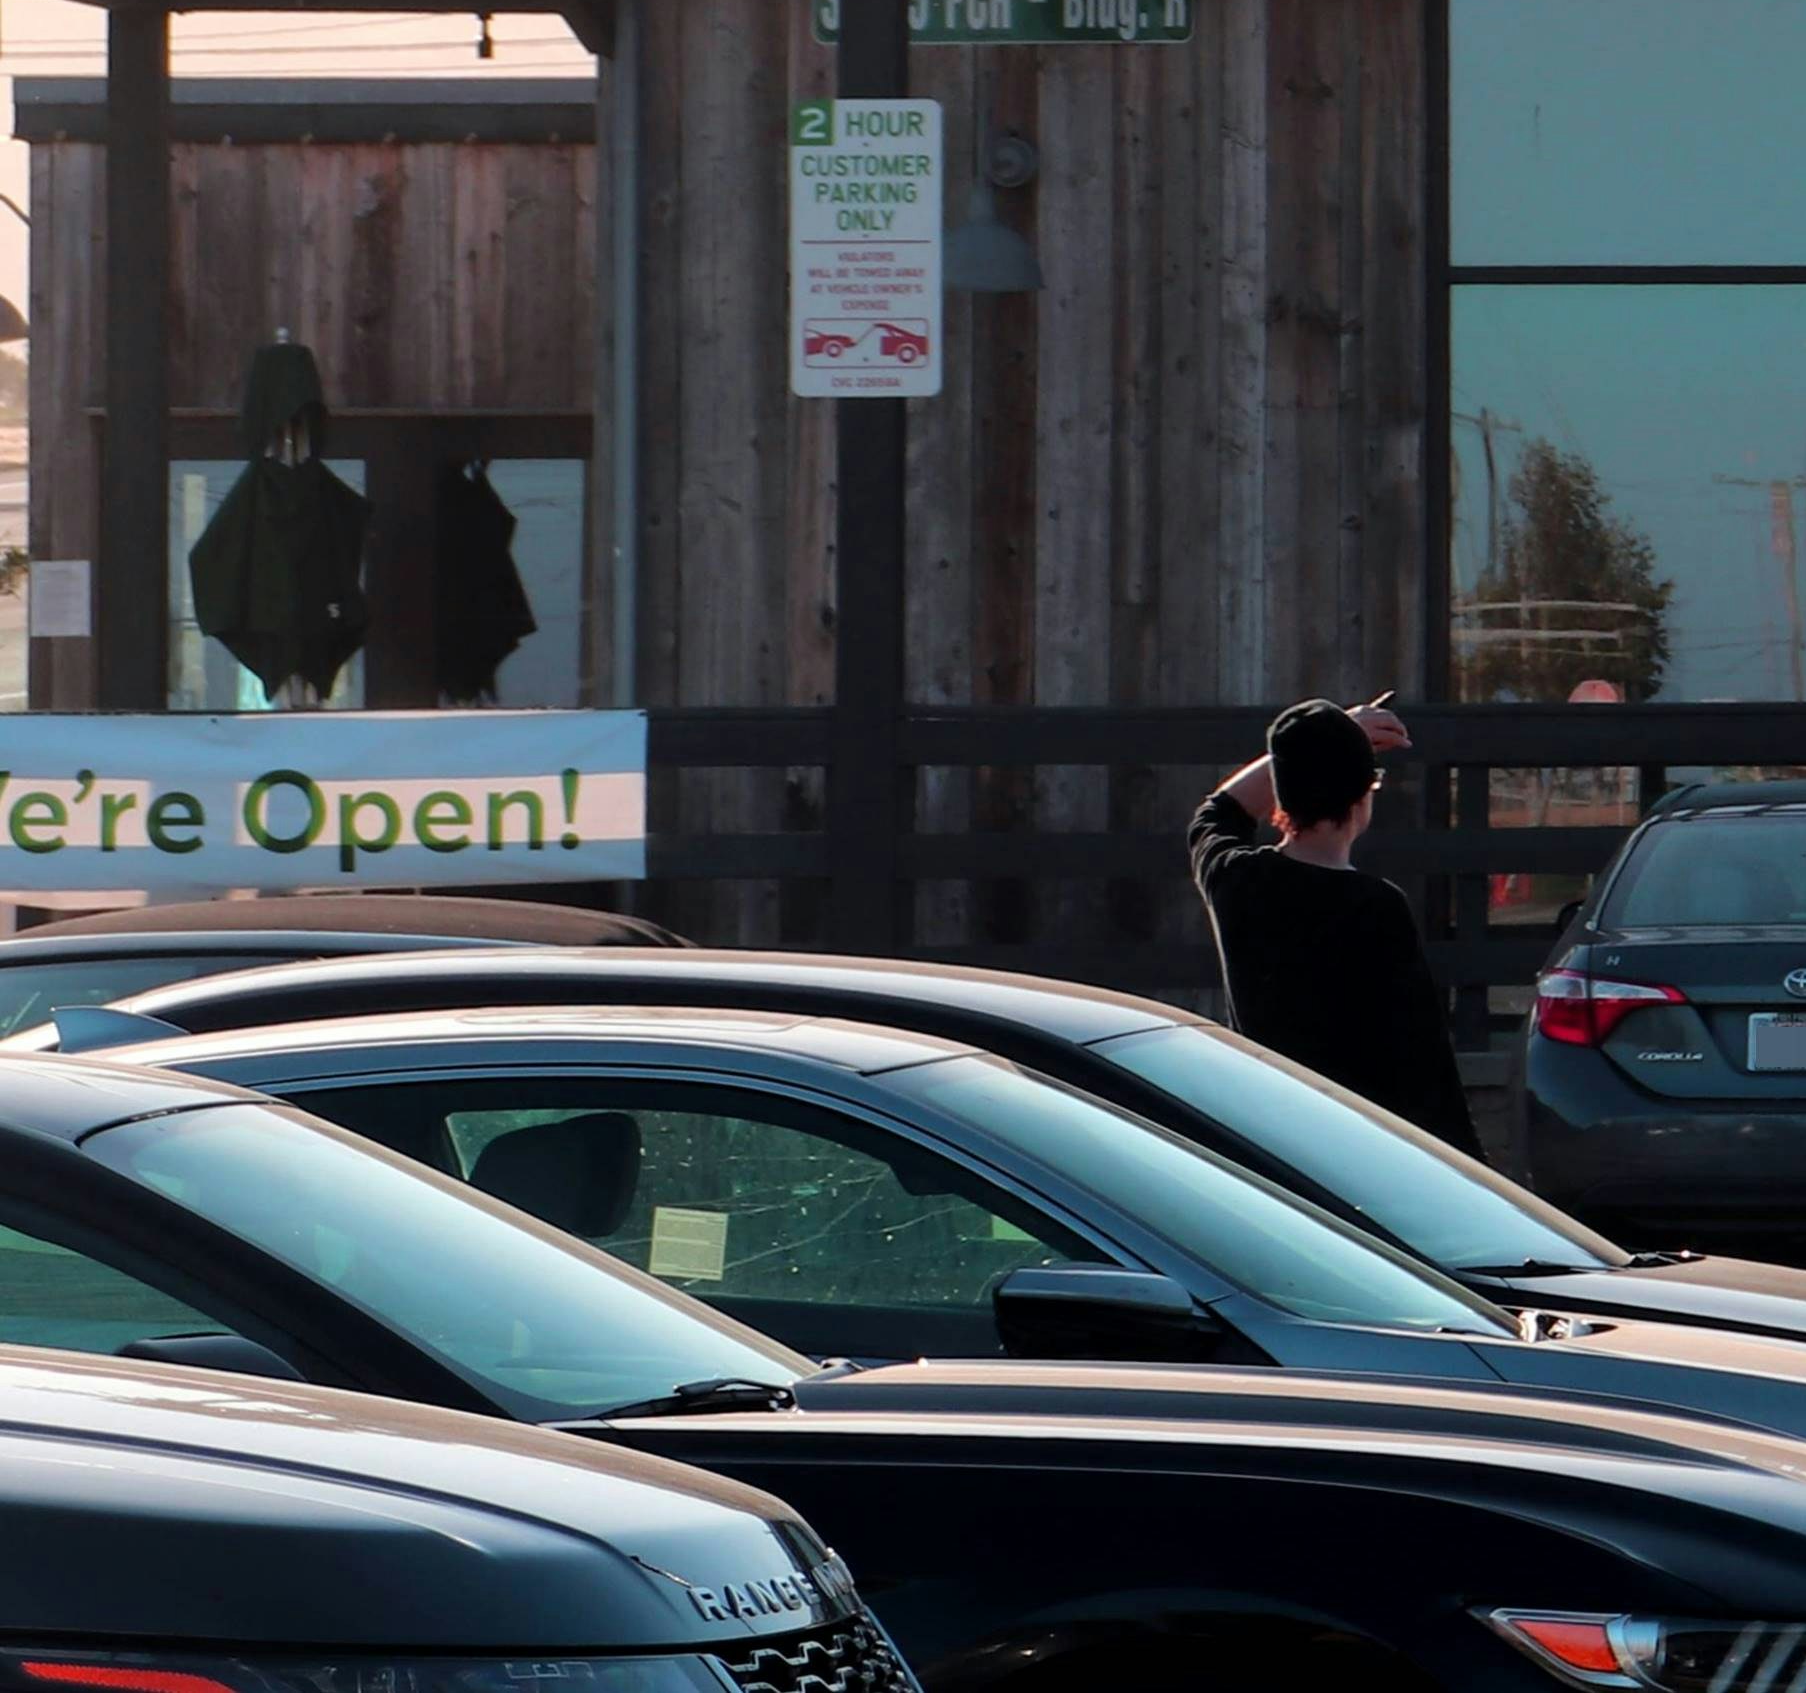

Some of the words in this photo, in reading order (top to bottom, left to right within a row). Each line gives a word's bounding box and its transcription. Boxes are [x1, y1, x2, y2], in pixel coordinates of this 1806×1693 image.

[799, 107, 827, 139] 2
[845, 110, 924, 137] HOUR
[800, 154, 931, 177] CUSTOMER
[815, 182, 918, 203] PARKING
[836, 209, 894, 231] ONLY
[243, 768, 580, 873] Open!
[1637, 1051, 1704, 1061] COROLLA
[687, 1571, 822, 1622] RANGE
